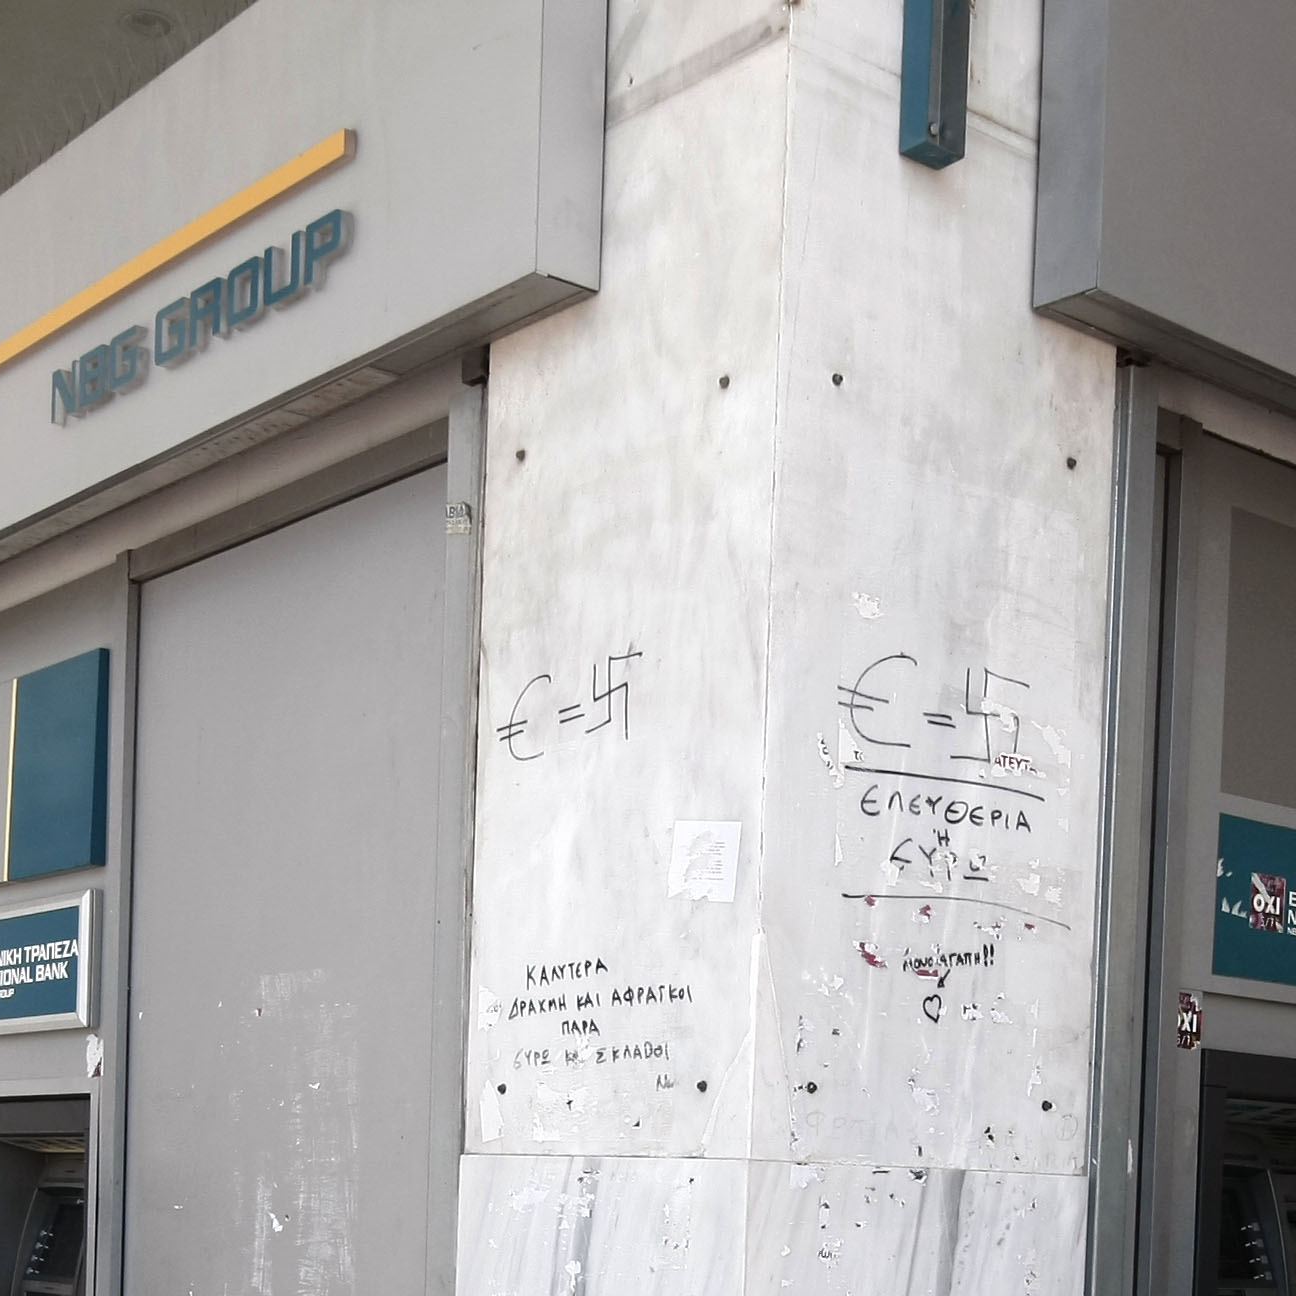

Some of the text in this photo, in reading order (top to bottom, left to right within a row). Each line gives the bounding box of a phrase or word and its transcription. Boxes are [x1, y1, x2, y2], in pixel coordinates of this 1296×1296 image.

[51, 208, 354, 427] NBG GROUP
[861, 785, 1032, 833] ΕΛΕΥΘΕΡΙΑ
[23, 938, 79, 964] ΤΡΑΠΕΖΑ
[35, 960, 69, 982] BANK
[526, 958, 608, 990] ΚΑΛΥΤΕΡΑ
[508, 984, 692, 1020] ΔΡΑΧΜΗ ΚΑΙ ΑΦΡΑΓΚΟΙ
[561, 1018, 601, 1036] ΠΑΡΑ
